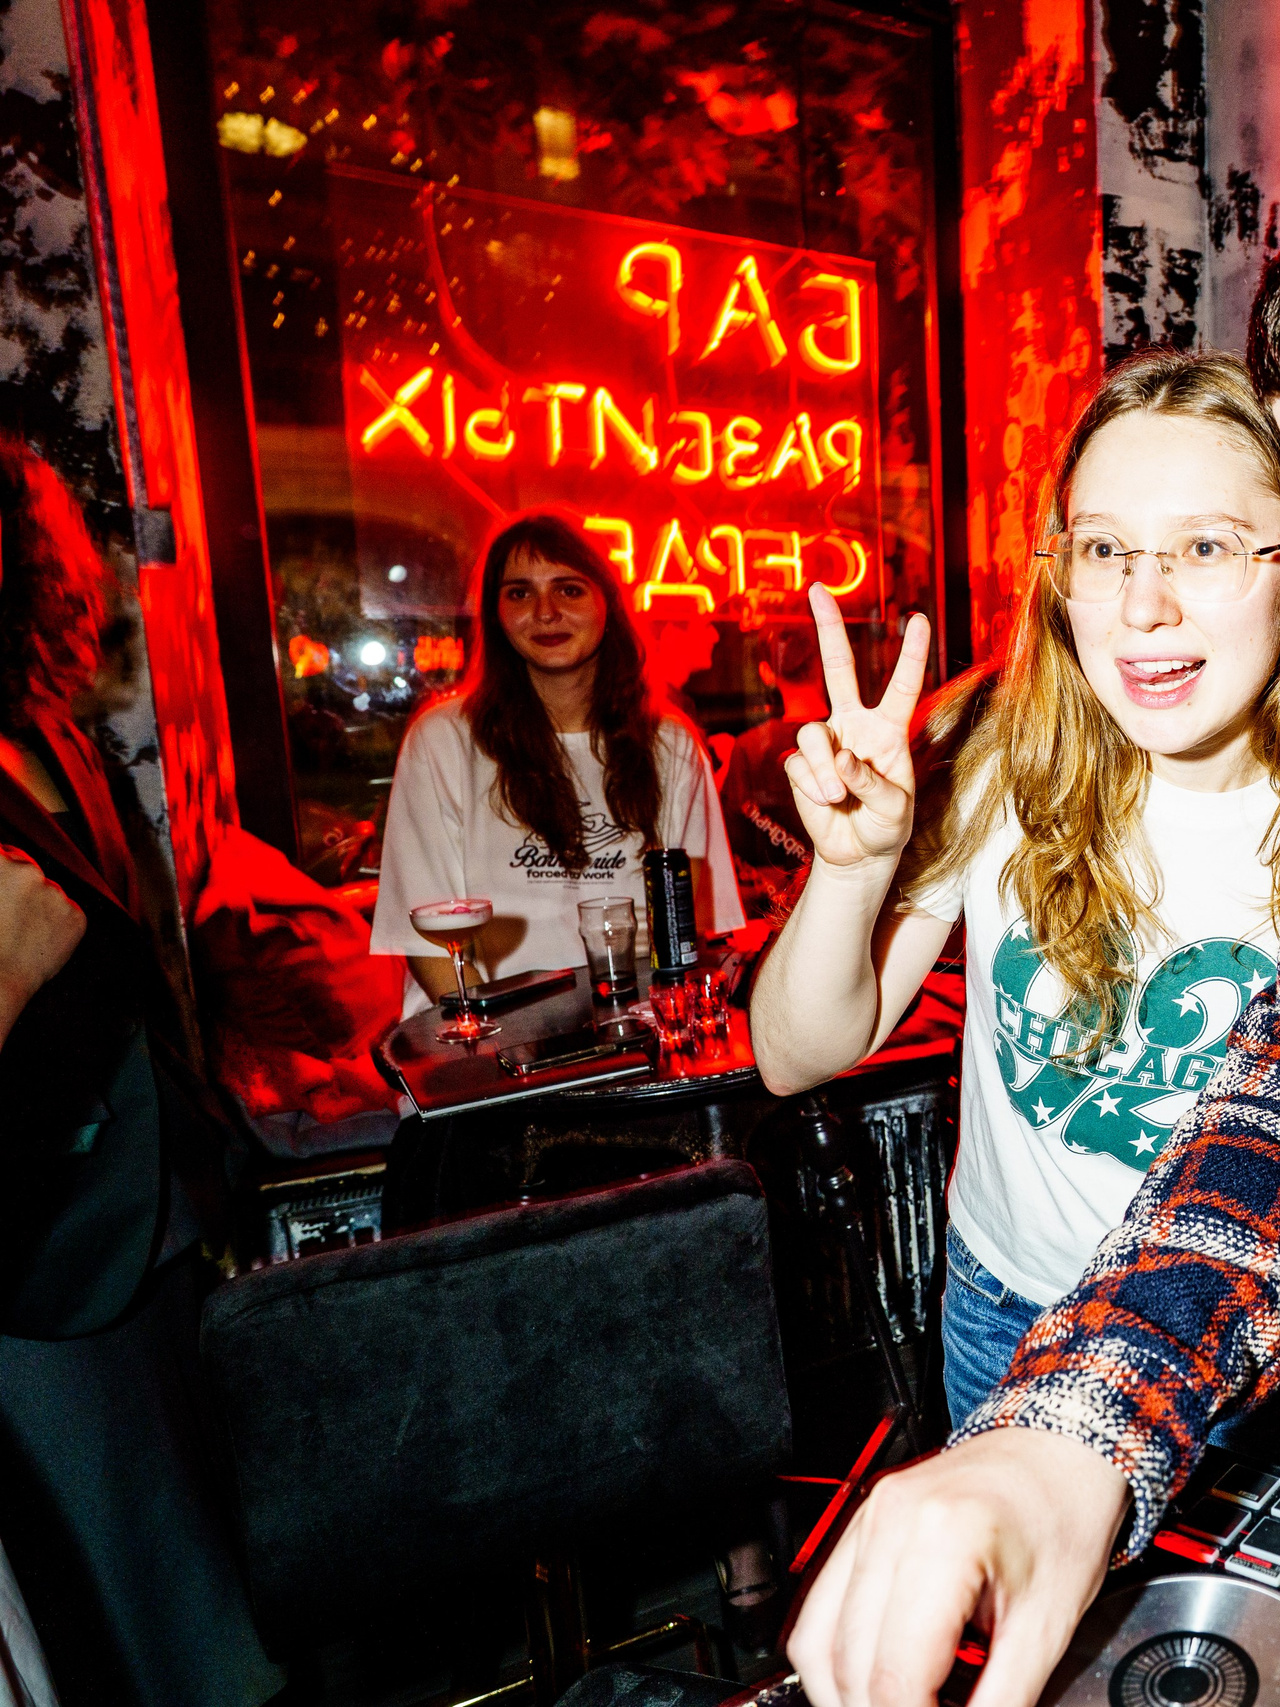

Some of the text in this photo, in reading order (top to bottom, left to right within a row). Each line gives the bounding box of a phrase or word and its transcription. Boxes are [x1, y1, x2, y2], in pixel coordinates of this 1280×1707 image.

[526, 869, 567, 878] forced
[582, 870, 615, 879] work
[993, 987, 1228, 1094] CHICAG
